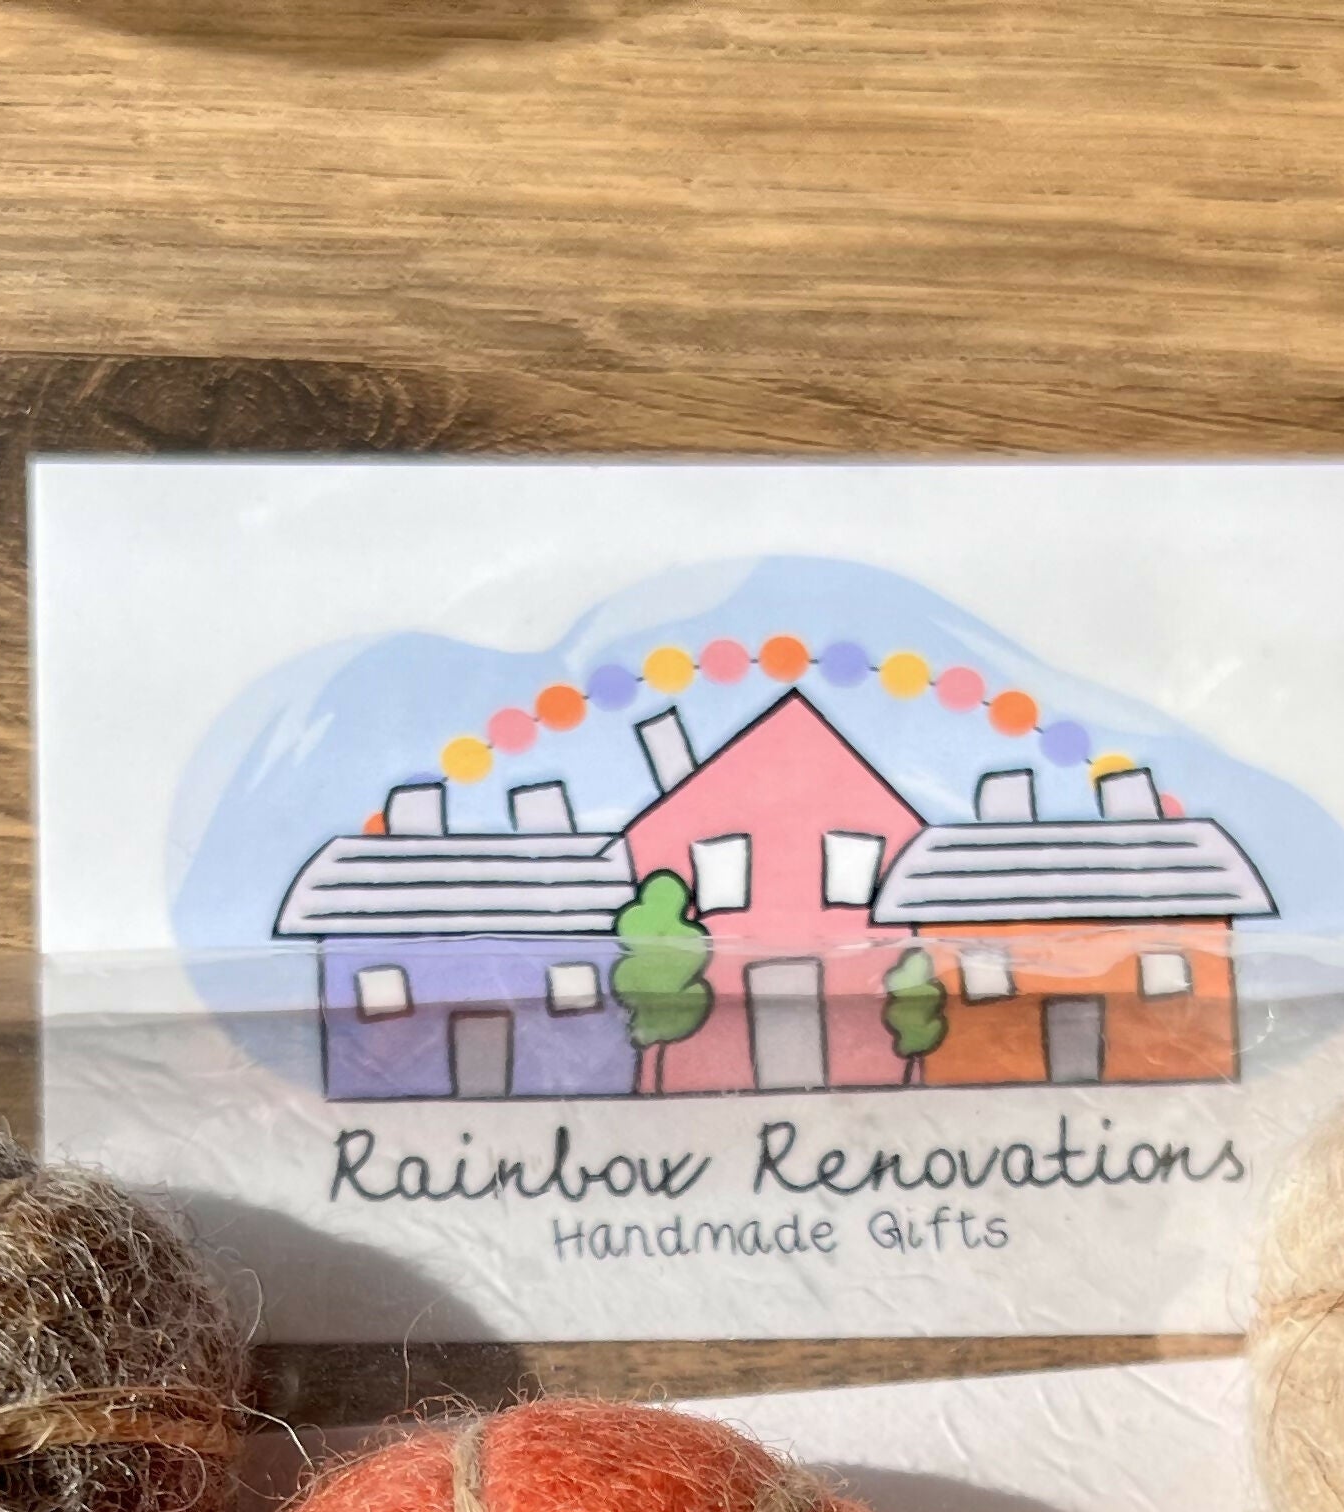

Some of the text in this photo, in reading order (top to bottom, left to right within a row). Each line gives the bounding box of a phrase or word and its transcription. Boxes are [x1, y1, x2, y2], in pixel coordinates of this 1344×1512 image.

[330, 1114, 1245, 1201] Rainbow Renovations
[552, 1207, 1010, 1260] Handmade Gifts
